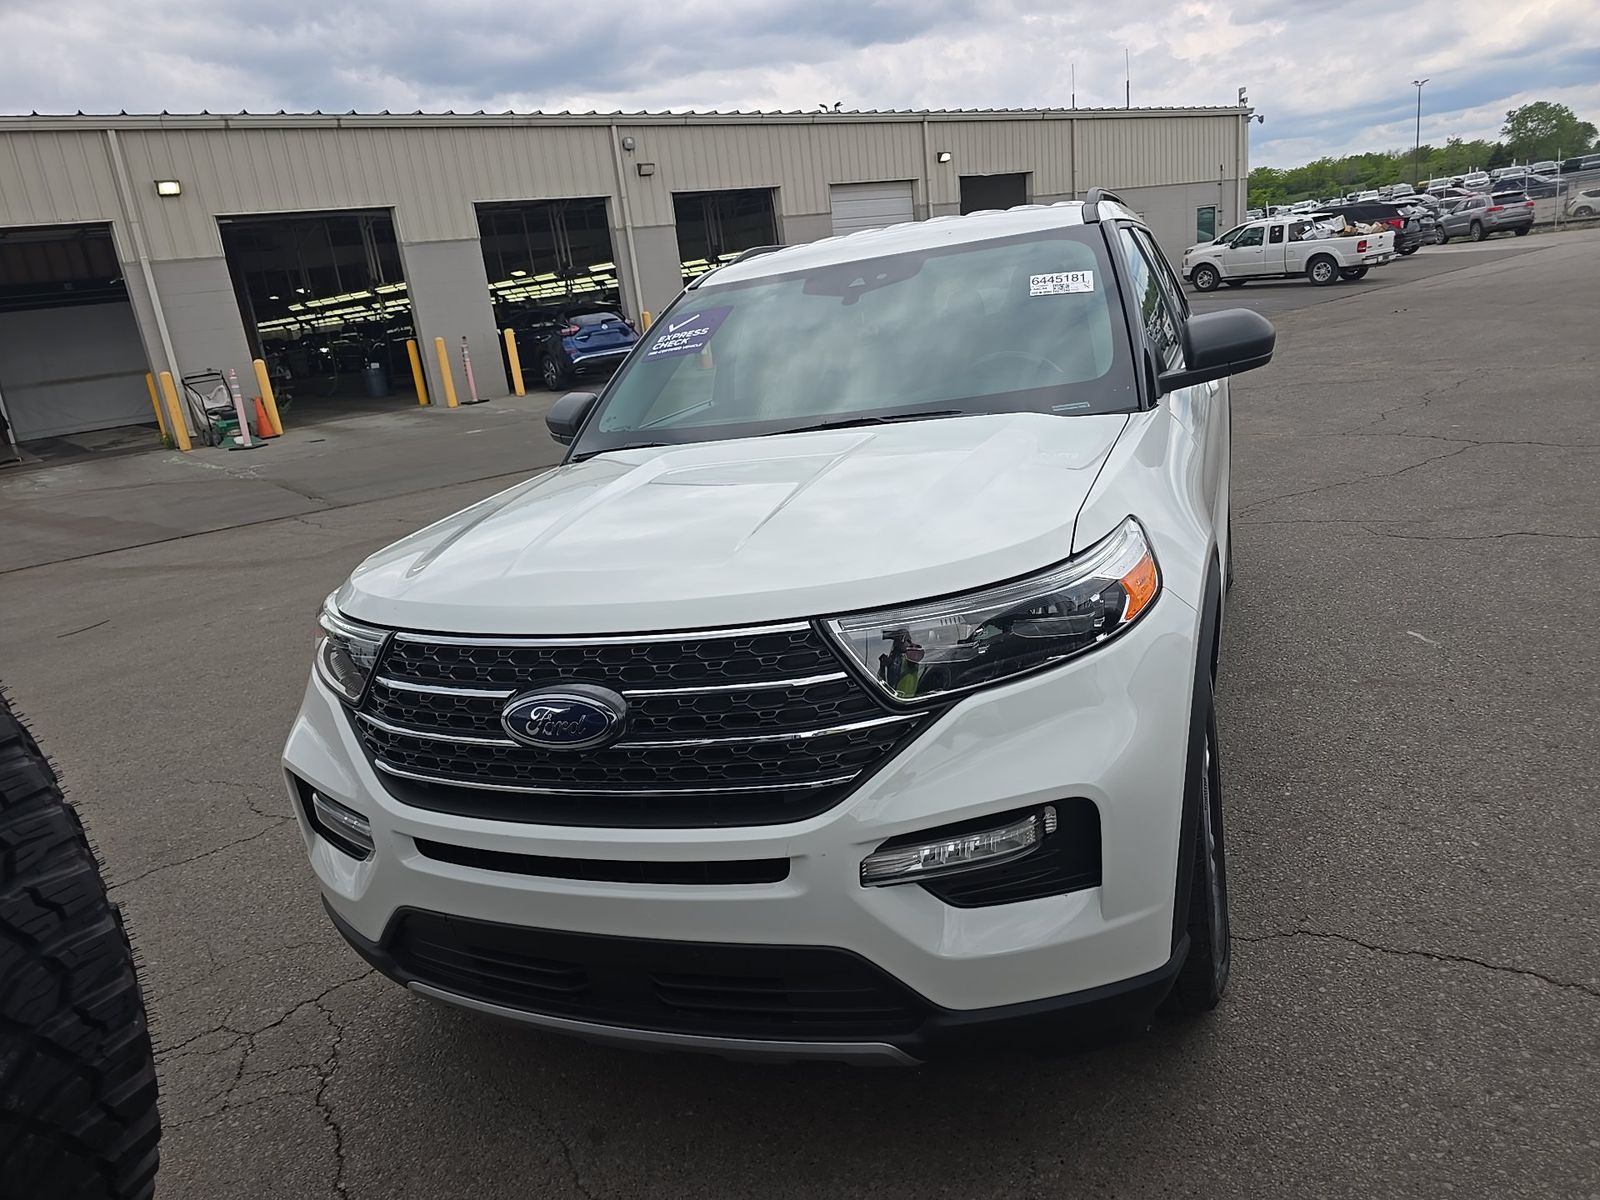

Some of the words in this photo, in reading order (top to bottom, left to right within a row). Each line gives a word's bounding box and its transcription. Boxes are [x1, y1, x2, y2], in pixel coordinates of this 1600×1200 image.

[1031, 273, 1085, 286] 6445181
[657, 327, 710, 343] EXPRESS
[652, 337, 691, 351] CHECK
[525, 706, 587, 736] Ford
